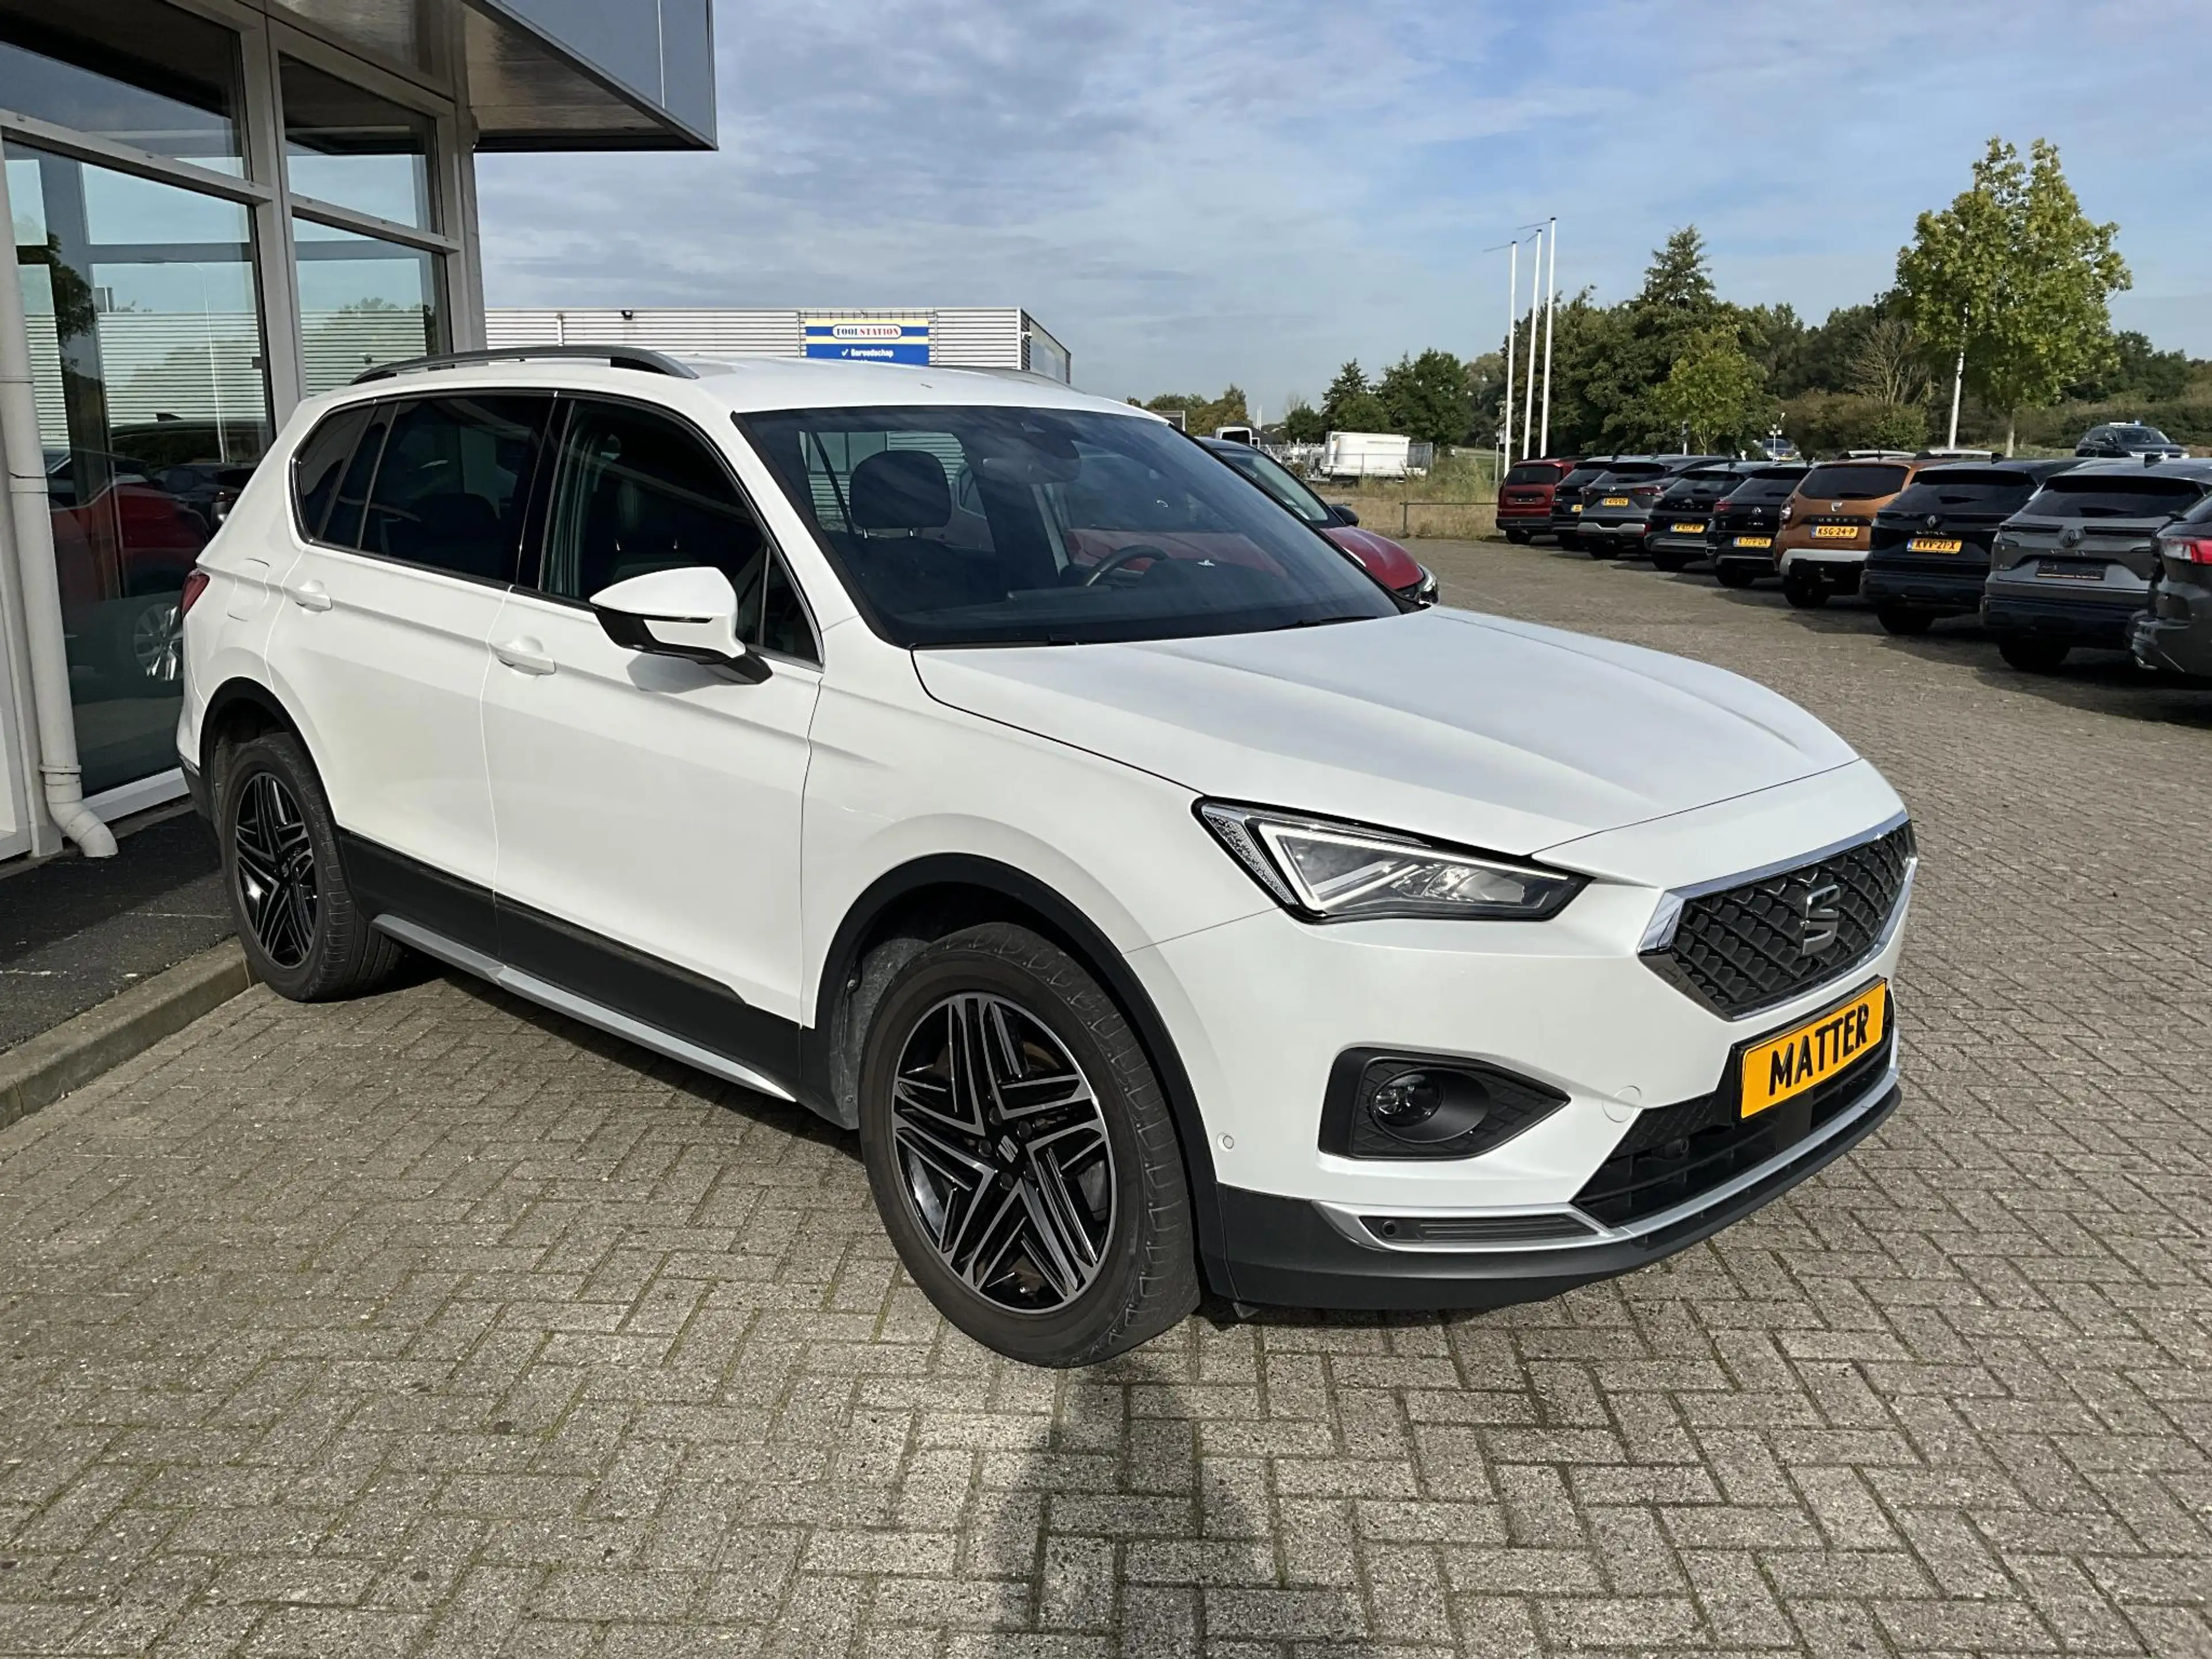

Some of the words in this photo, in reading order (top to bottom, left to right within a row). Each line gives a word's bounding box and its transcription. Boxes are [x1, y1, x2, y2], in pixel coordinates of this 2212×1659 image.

[836, 328, 899, 336] TOOLSTATION
[1817, 527, 1855, 536] KSG-24-P
[1768, 1003, 1869, 1096] MATTER
